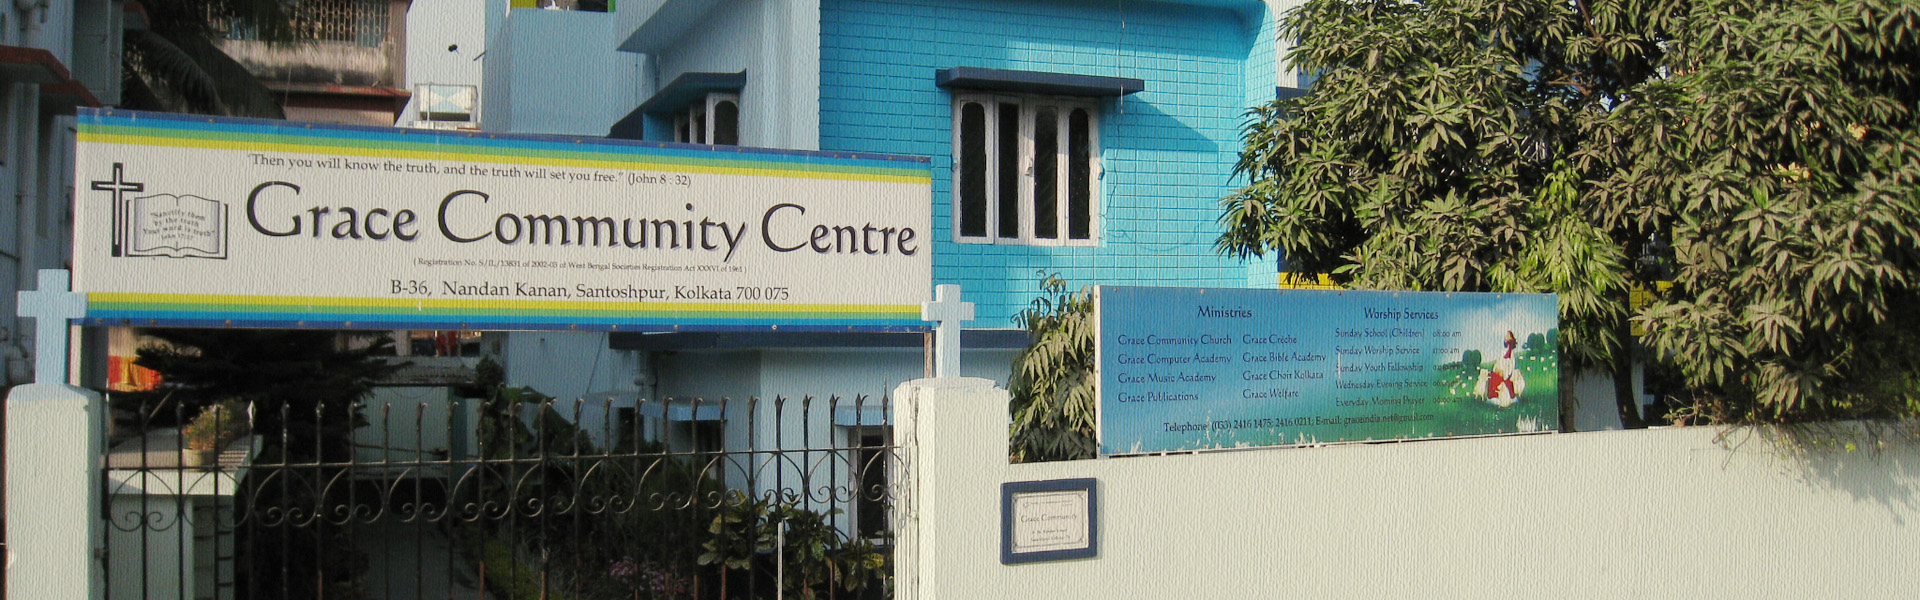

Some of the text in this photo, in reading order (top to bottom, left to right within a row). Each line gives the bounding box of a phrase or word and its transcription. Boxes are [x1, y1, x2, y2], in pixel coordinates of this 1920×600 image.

[288, 158, 312, 170] you
[317, 157, 340, 169] will
[344, 158, 379, 171] know
[384, 160, 402, 173] the
[406, 161, 440, 175] truth,
[443, 164, 466, 176] and
[469, 165, 488, 177] the
[491, 166, 521, 178] truth
[524, 168, 547, 180] will
[550, 169, 566, 180] set
[569, 172, 590, 184] you
[628, 174, 657, 186] (John
[674, 175, 692, 188] 32)
[247, 181, 919, 263] Grace Community Centre
[418, 257, 463, 267] Registration
[464, 258, 476, 266] No.
[523, 260, 530, 268] of
[560, 261, 566, 269] of
[568, 261, 585, 269] West
[587, 262, 611, 272] Bengal
[642, 263, 682, 273] Registration
[684, 264, 696, 272] Act
[720, 265, 728, 273] of
[390, 279, 789, 302] B-36, Nandan Kanan, Santoshpur, Kolkata 700 075
[1197, 305, 1252, 319] Ministries
[1364, 307, 1439, 320] Worship Services
[1242, 334, 1268, 345] Grace
[1335, 327, 1425, 339] Sunday School (Children)
[1118, 334, 1233, 347] Grace Community Church
[1335, 345, 1420, 356] Sunday Worship Service
[1118, 353, 1232, 366] Grace Computer Academy
[1242, 351, 1327, 364] Grace Bible Academy
[1364, 362, 1386, 372] Youth
[1387, 362, 1424, 373] Fellowship
[1118, 372, 1216, 384] Grace Music Academy
[1242, 370, 1325, 382] Grace Choir Kolkata
[1335, 380, 1374, 390] Wednesday
[1376, 379, 1403, 390] Evening
[1403, 378, 1428, 389] Service
[1118, 391, 1199, 404] Grace Publications
[1242, 388, 1299, 400] Grace Welfare
[1335, 394, 1425, 408] Everyday Morning Prayer
[1233, 419, 1252, 430] 2416
[1275, 417, 1293, 428] 2416
[1020, 512, 1078, 524] Grace Community
